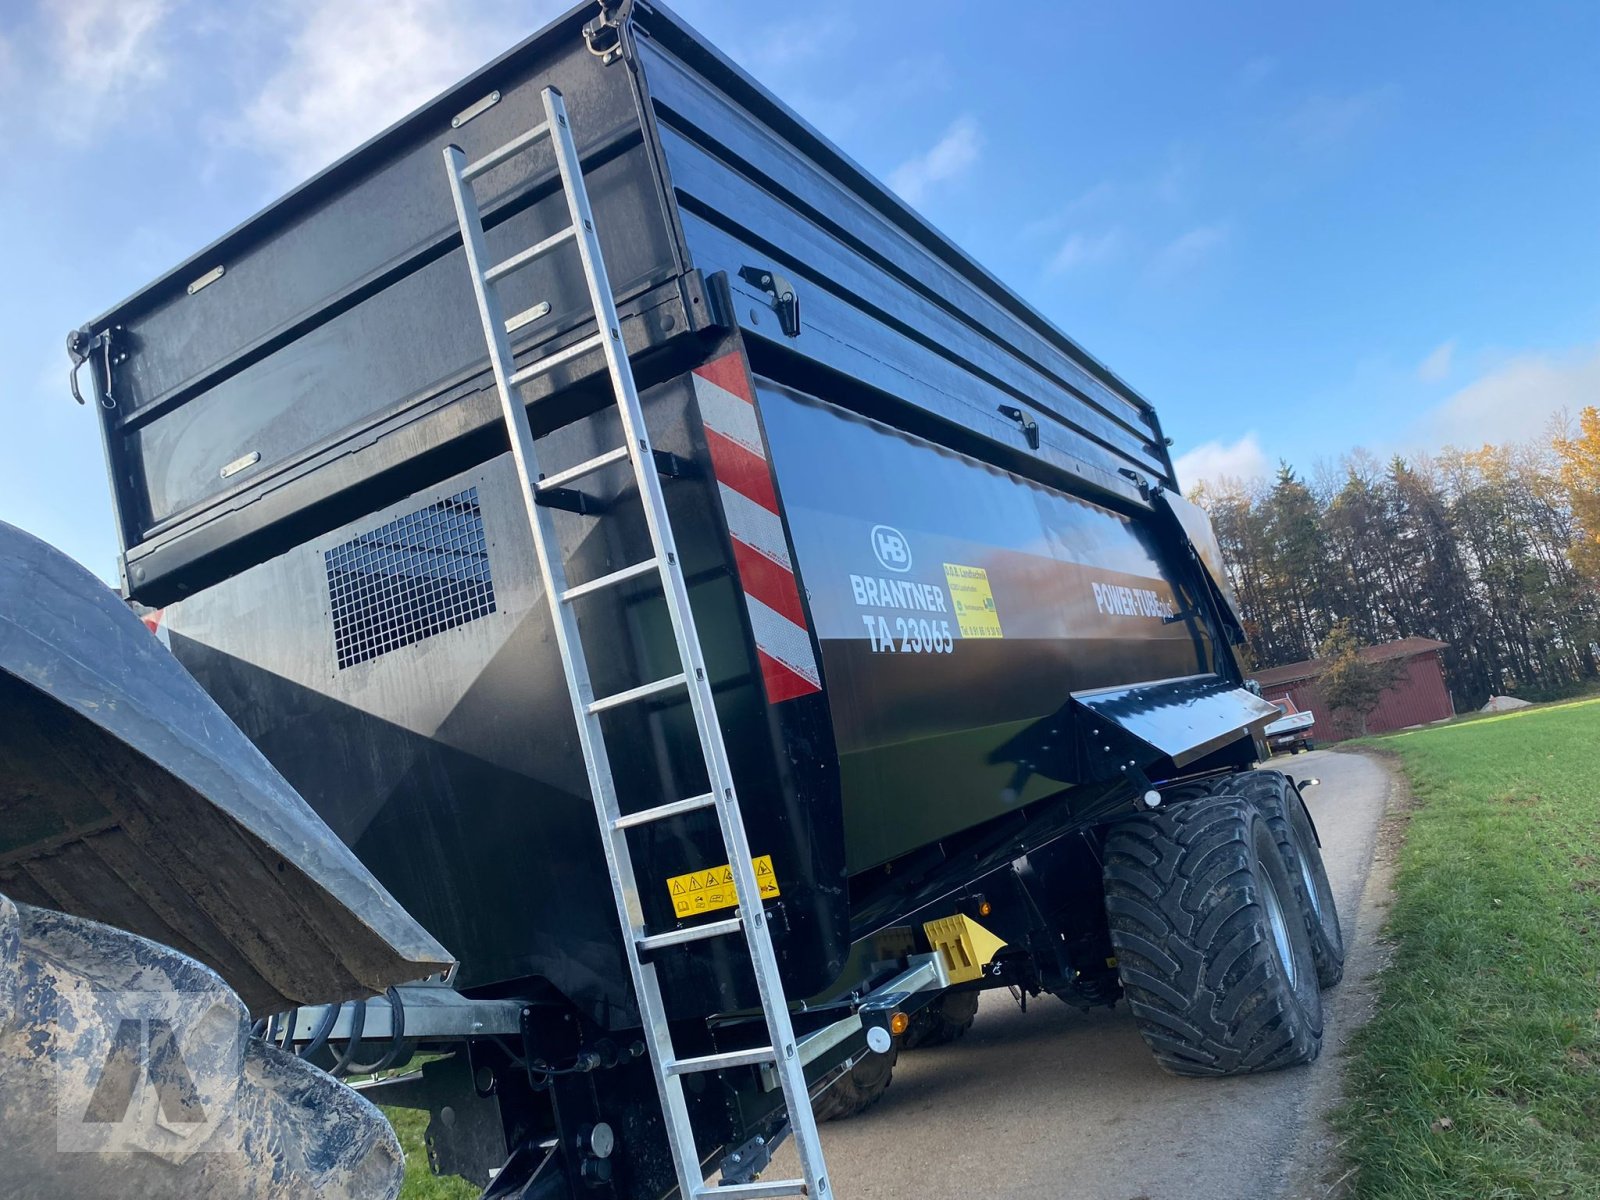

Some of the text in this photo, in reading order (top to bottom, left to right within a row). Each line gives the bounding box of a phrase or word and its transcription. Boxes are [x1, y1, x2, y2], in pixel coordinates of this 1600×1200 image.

[877, 533, 907, 563] HB
[849, 574, 948, 613] BRANTNER
[862, 615, 954, 654] TA 23065
